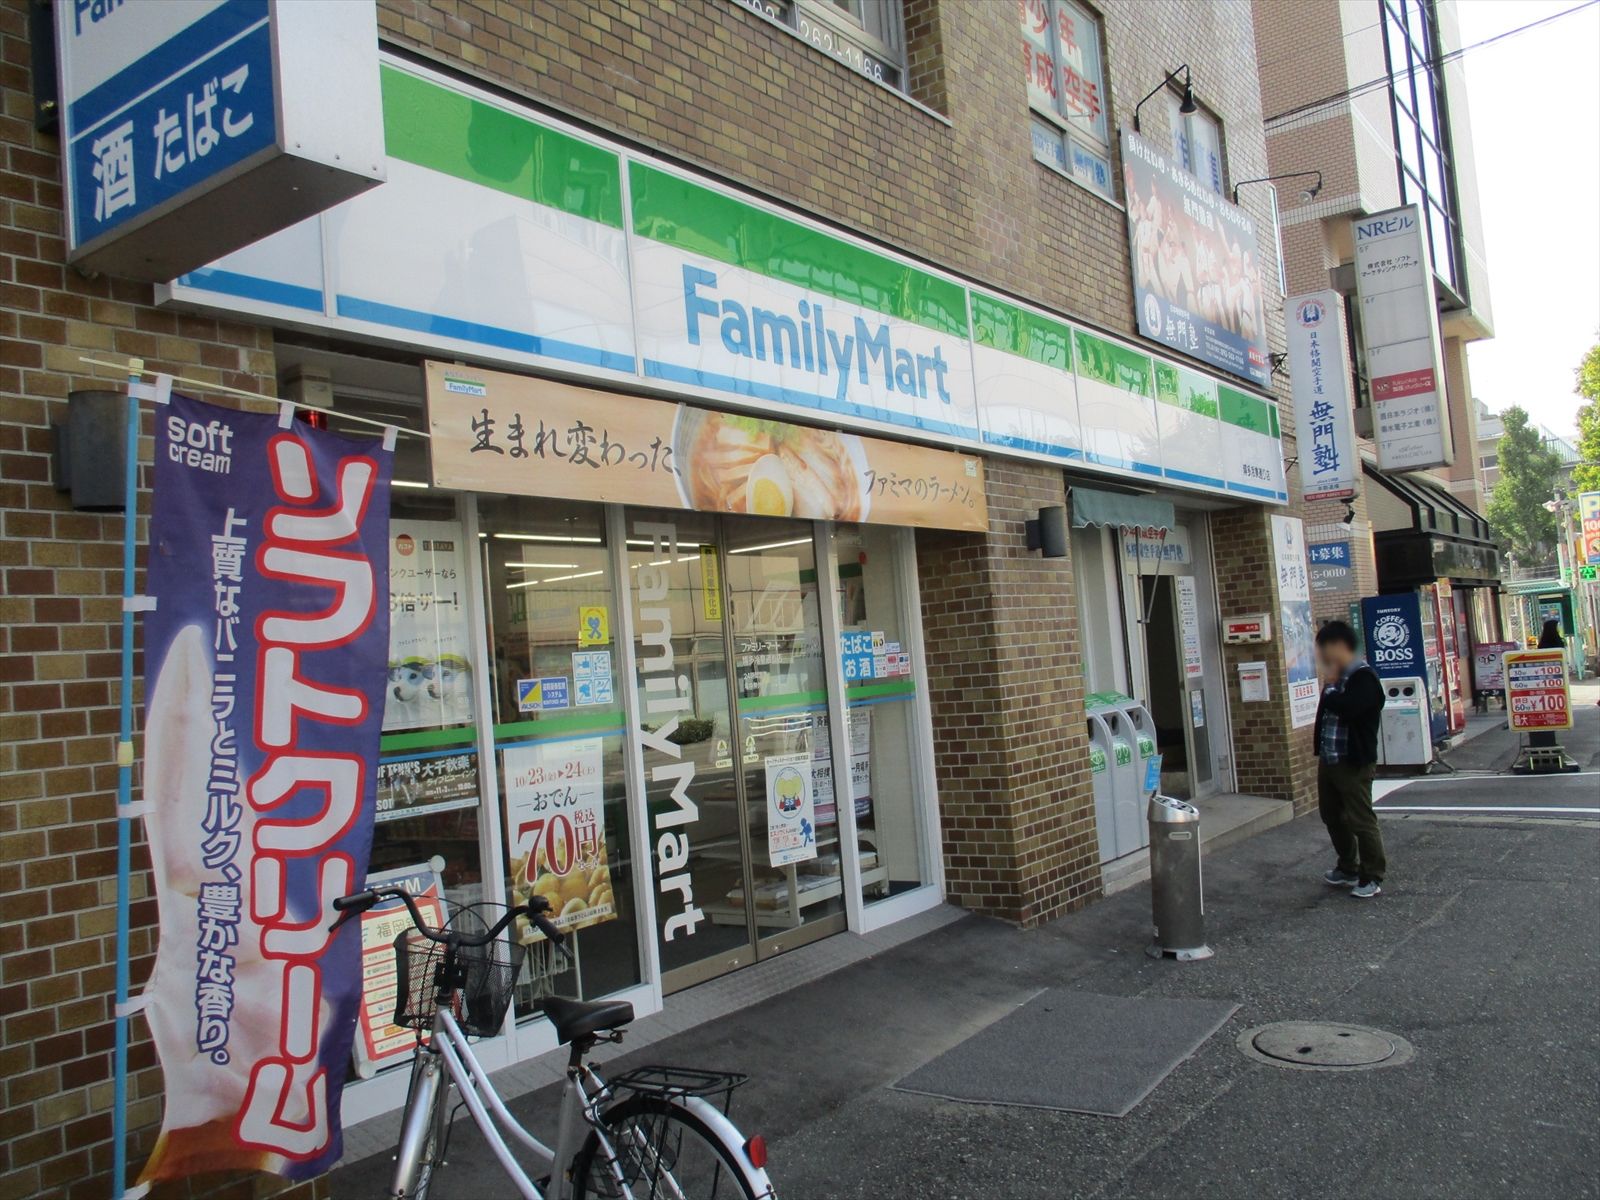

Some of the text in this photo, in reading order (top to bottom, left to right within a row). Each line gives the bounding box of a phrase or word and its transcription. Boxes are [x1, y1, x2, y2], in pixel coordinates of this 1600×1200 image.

[92, 63, 254, 222] 酒 たばこ
[1357, 216, 1414, 241] NRビル
[682, 263, 951, 404] FamilyMart
[448, 382, 483, 396] FamilyMart
[168, 415, 234, 455] soft
[470, 408, 682, 477] 生まれ変わった、
[1309, 400, 1341, 476] 無門塾
[168, 441, 232, 475] cream
[863, 470, 977, 509] ファミマのラーメン。
[1310, 546, 1345, 561] ト募集
[1375, 615, 1405, 626] COFFEE
[740, 641, 781, 652] ファミリーマート
[840, 634, 872, 654] たばこ
[1375, 647, 1413, 662] BOSS
[845, 657, 872, 678] お酒
[1536, 678, 1562, 687] ¥100
[1530, 695, 1565, 711] ¥100
[632, 521, 705, 942] FamilyMart
[422, 755, 470, 777] 大千秋楽
[197, 507, 249, 1067] 上質なバニラとミルク、豊かな香り。
[232, 432, 378, 1161] ソフトクリーム
[533, 786, 578, 811] おでん
[574, 807, 595, 825] 税込
